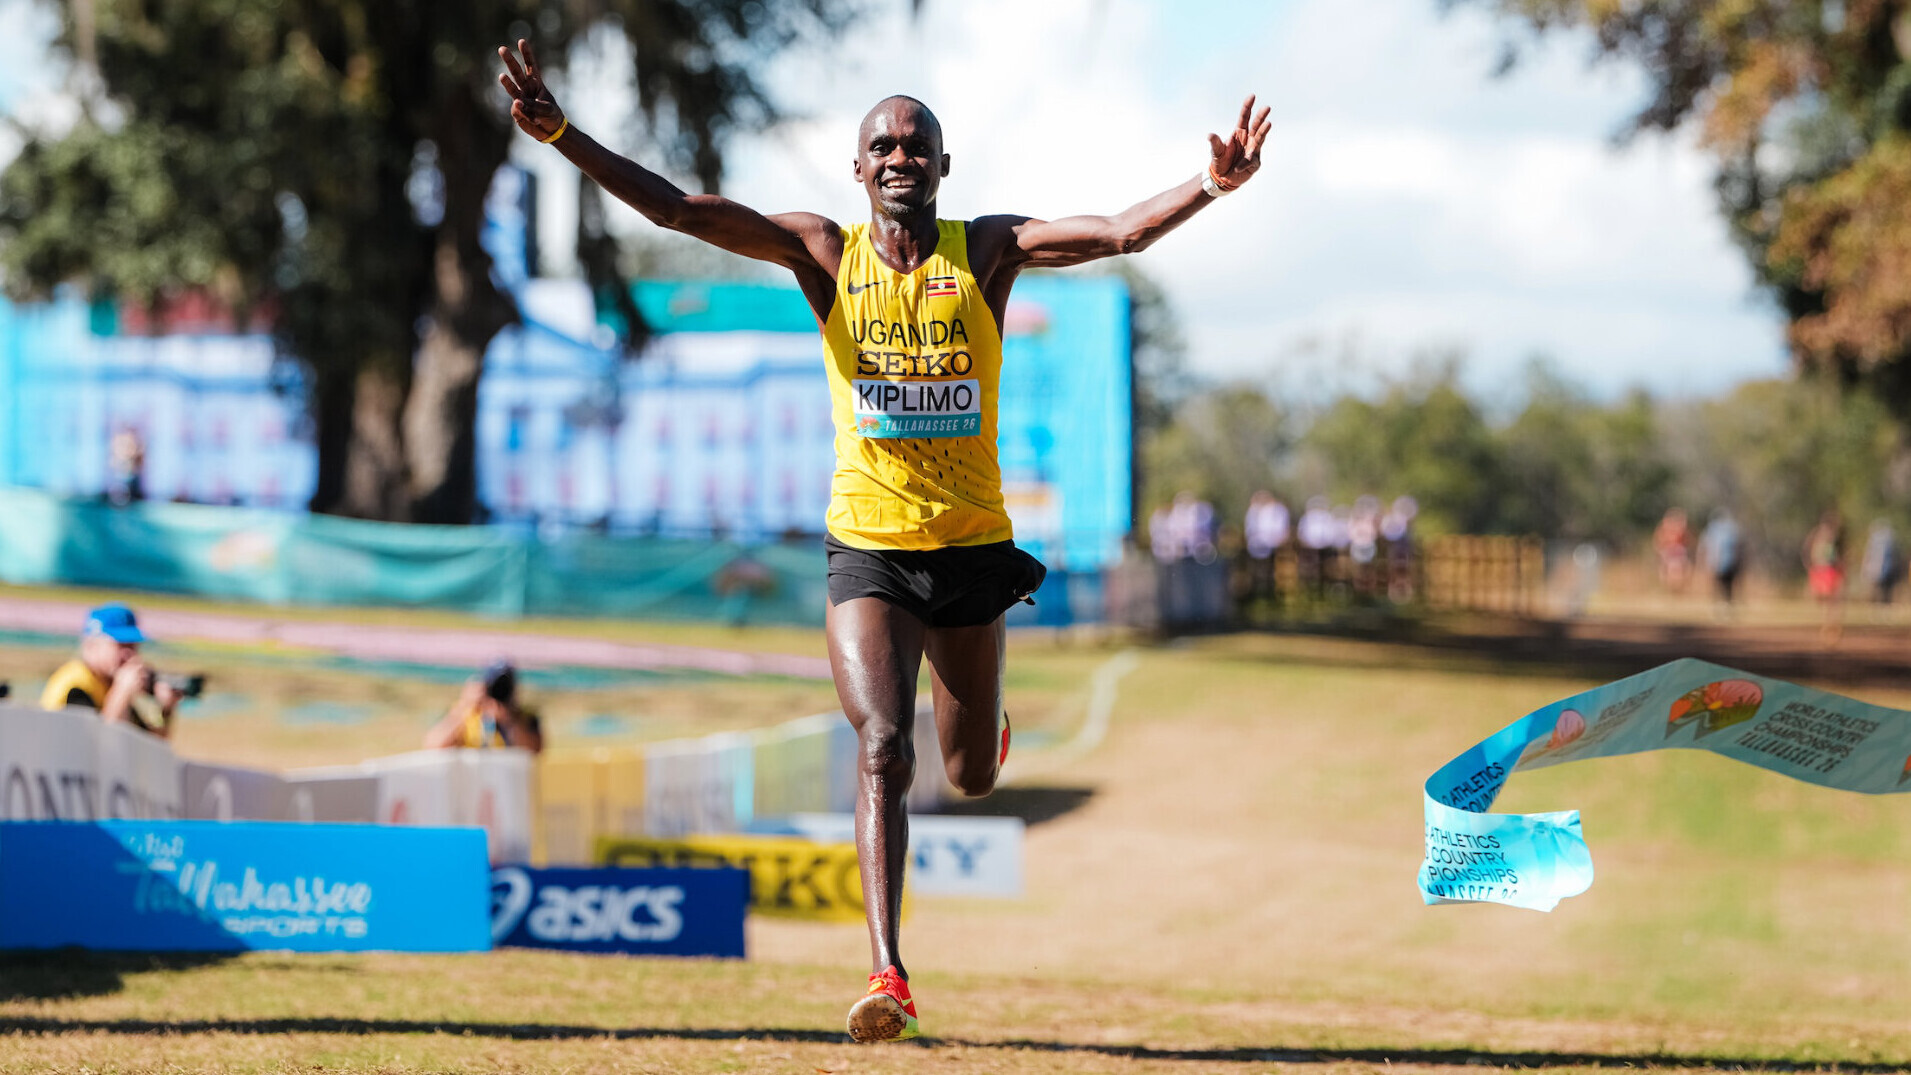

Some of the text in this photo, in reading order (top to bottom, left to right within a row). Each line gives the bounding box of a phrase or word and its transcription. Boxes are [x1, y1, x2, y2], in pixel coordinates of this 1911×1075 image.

[852, 318, 969, 347] UGANDA
[857, 350, 973, 377] SEIKO
[859, 384, 973, 411] KIPLIMO
[885, 418, 976, 432] TALLAHASSEE 26
[1784, 702, 1881, 733] WORLD ATHLETICS
[1754, 721, 1853, 759] CHAMPIONSHIPS
[1810, 721, 1867, 744] COUNTRY
[1450, 762, 1504, 805] ATHLETICS
[1430, 827, 1500, 849] ATHLETICS
[1431, 846, 1507, 865] COUNTRY
[1427, 865, 1518, 884] PIONSHIPS
[526, 885, 685, 942] asics
